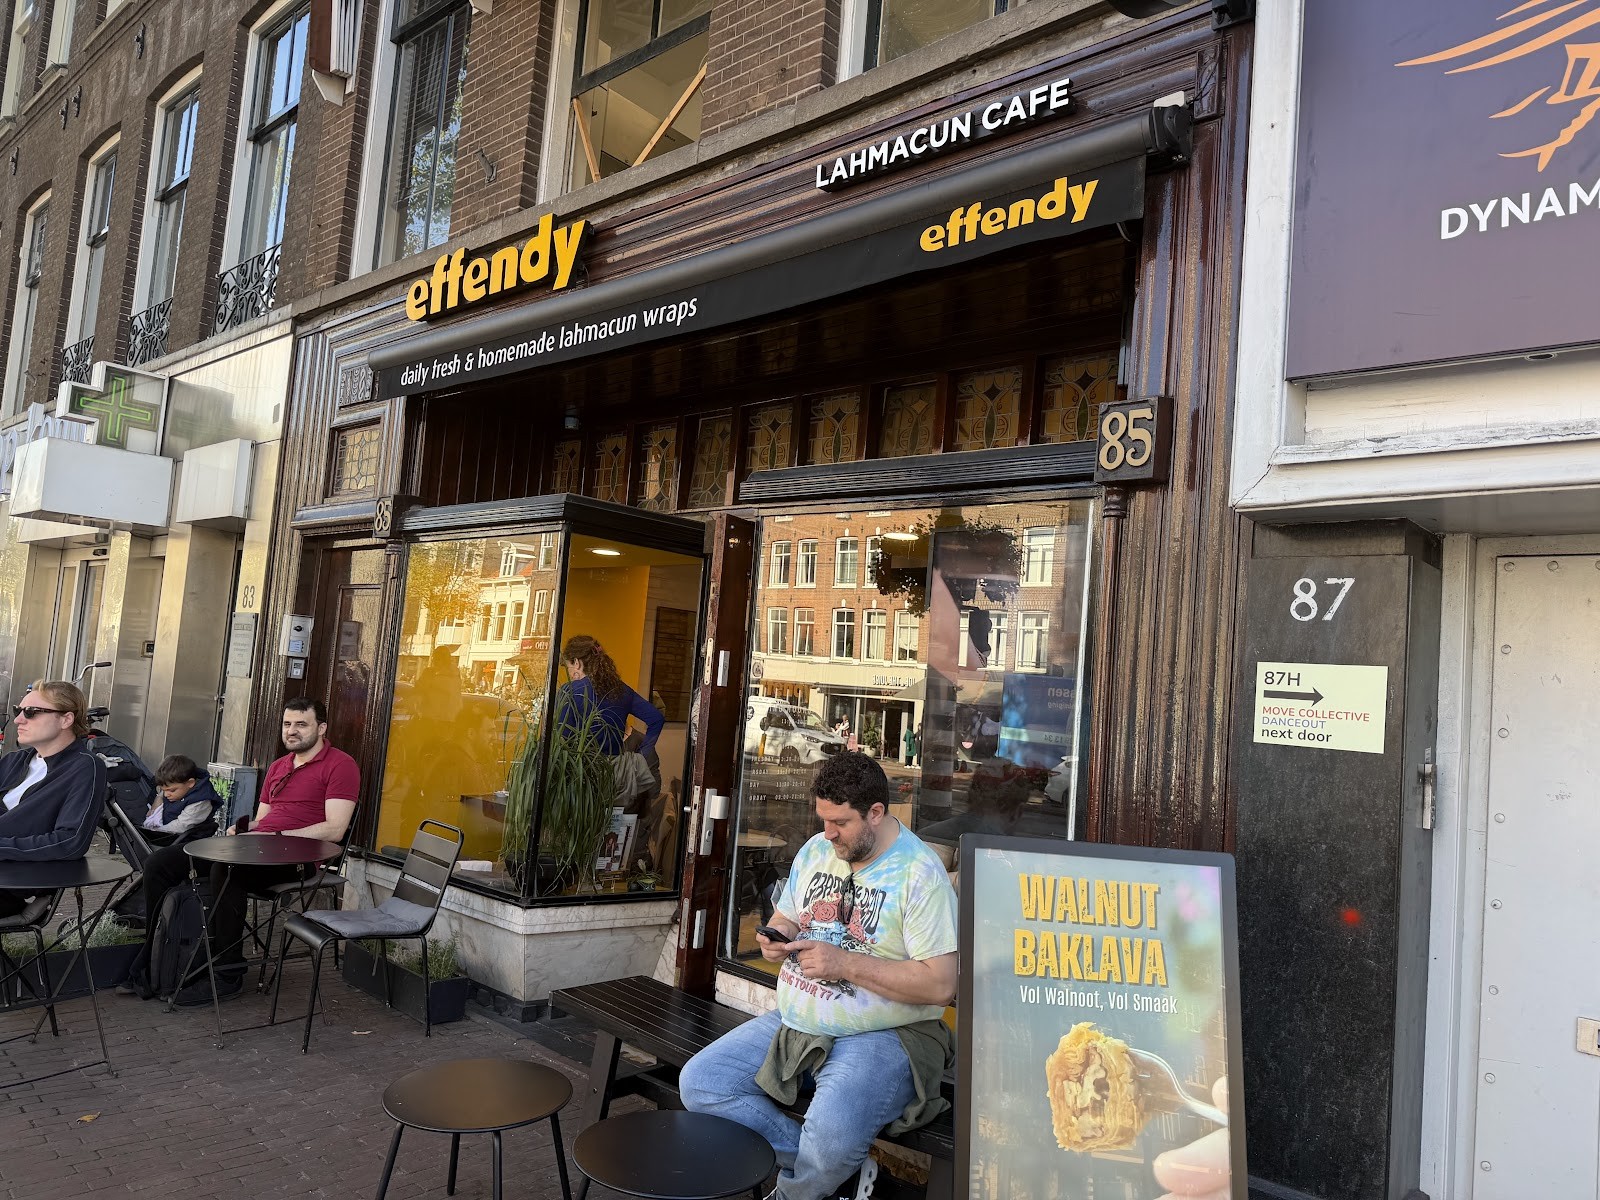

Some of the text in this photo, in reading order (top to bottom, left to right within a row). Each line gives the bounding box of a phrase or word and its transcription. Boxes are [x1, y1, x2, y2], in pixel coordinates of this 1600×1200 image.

[816, 78, 1070, 188] LAHMACUN CAFE
[920, 177, 1098, 251] effendy
[1441, 177, 1600, 240] DYNAM
[406, 213, 587, 321] effendy
[401, 298, 698, 387] daily fresh & homemade lahmacun wraps
[1099, 408, 1153, 470] 85
[375, 500, 391, 532] 85
[242, 585, 255, 609] 83
[1290, 577, 1356, 622] 87
[1264, 671, 1301, 686] 87H
[1261, 728, 1333, 742] next door
[1262, 706, 1370, 722] MOVE COLLECTIVE
[1262, 716, 1326, 729] DANCEOUT
[1019, 873, 1160, 928] WALNUT
[1014, 928, 1168, 986] BAKLAVA
[795, 977, 818, 998] TOUR
[1020, 984, 1178, 1014] Vol Walnoot, Vol Smaak
